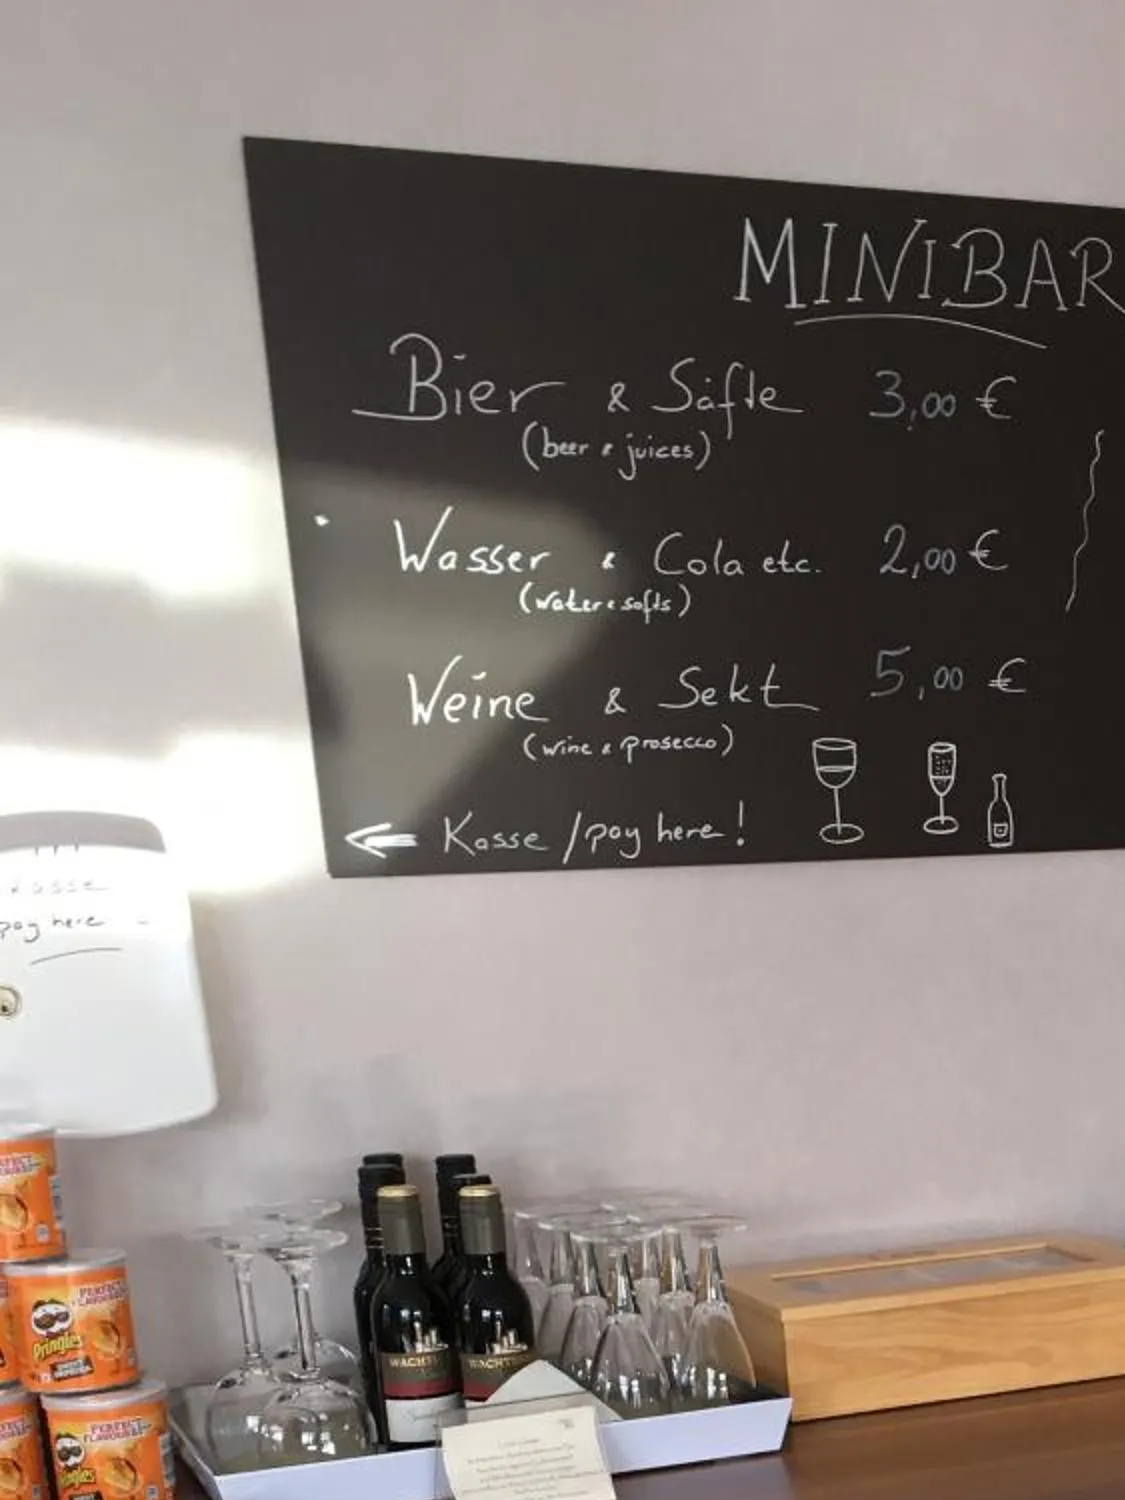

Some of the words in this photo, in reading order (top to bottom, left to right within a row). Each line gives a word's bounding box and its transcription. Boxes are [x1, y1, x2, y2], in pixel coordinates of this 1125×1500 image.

[352, 332, 567, 421] Bier
[607, 382, 630, 412] &
[868, 369, 958, 430] 3,00
[974, 375, 1018, 420] €
[521, 420, 590, 472] (beer
[618, 430, 711, 481] juices)
[393, 505, 552, 576] Wasser
[653, 531, 745, 576] Cola
[762, 539, 823, 576] etc.
[879, 524, 956, 580] 2,00
[969, 527, 1008, 572] €
[620, 583, 692, 624] softs)
[407, 655, 550, 726] Weine
[603, 687, 627, 716] &
[658, 663, 820, 711] Sekt
[872, 648, 964, 700] 5,00
[989, 658, 1027, 694] €
[523, 732, 594, 762] (wine
[619, 723, 735, 765] prosecco)
[443, 811, 550, 857] Kasse
